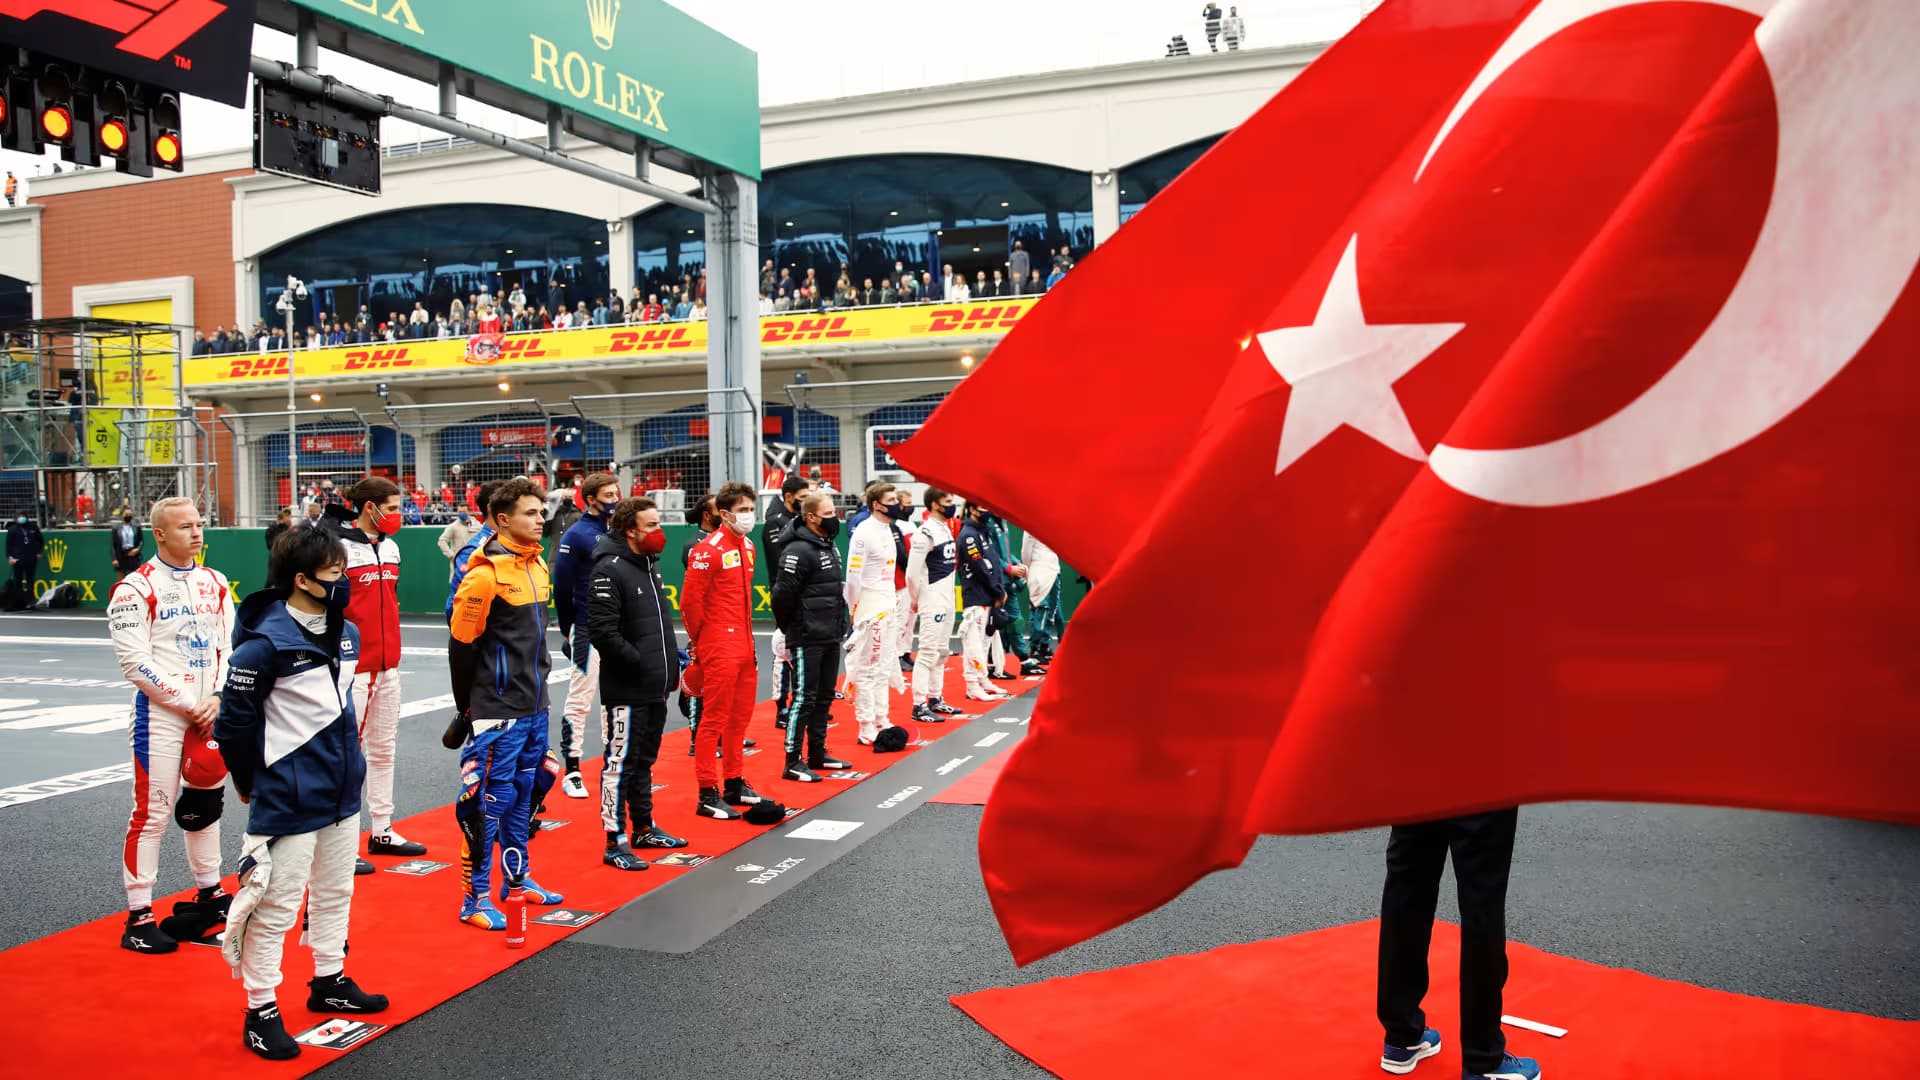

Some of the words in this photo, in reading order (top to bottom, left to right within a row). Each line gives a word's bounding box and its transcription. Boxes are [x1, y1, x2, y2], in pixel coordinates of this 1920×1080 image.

[174, 54, 192, 71] TM
[529, 34, 669, 132] ROLEX
[609, 327, 692, 352] DHL
[761, 316, 854, 343] DHL
[344, 348, 413, 370] DHL
[497, 338, 546, 359] HL
[229, 357, 290, 378] DHL
[610, 707, 625, 772] LPINE
[747, 857, 806, 885] ROLEX
